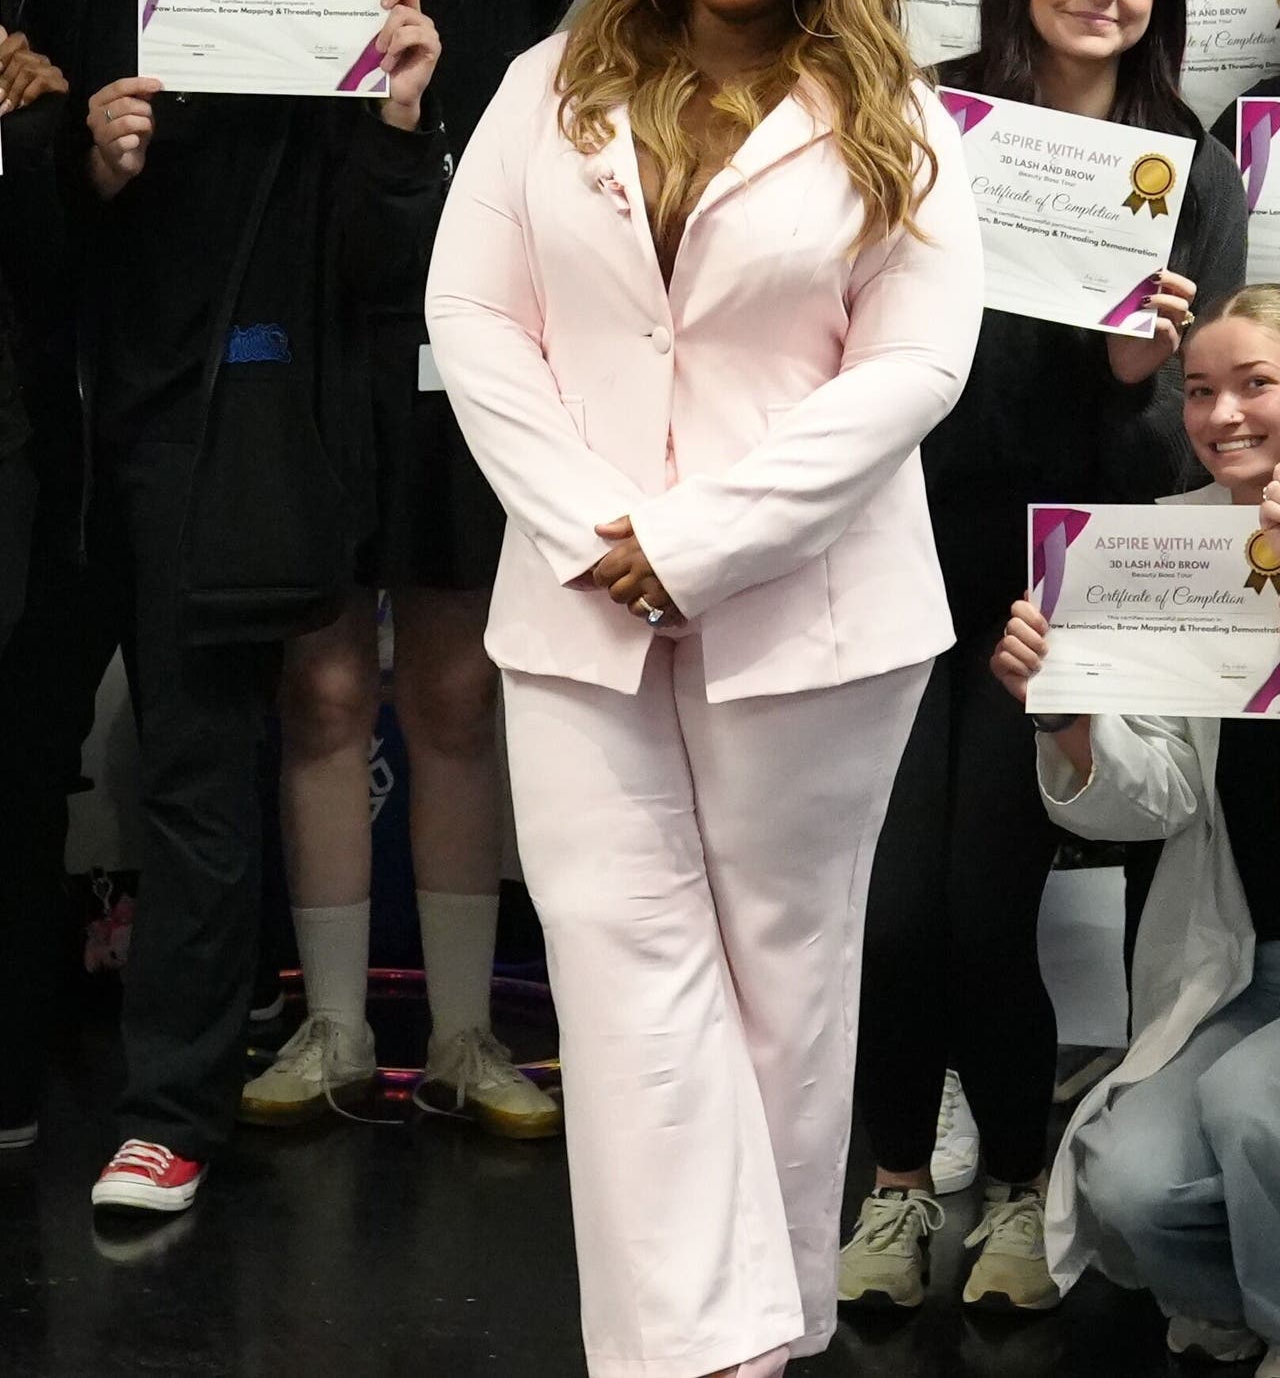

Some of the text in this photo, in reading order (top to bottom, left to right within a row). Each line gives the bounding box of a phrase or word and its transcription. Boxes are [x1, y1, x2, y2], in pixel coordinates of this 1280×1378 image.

[990, 131, 1123, 168] ASPIRE WITH AMY
[999, 154, 1096, 182] 3D LASH AND BROW
[970, 176, 1120, 222] Certificate of Completion
[1095, 536, 1234, 551] ASPIRE WITH AMY
[1109, 559, 1210, 570] 3D LASH AND BROW
[1086, 584, 1245, 611] Certificate of Completion
